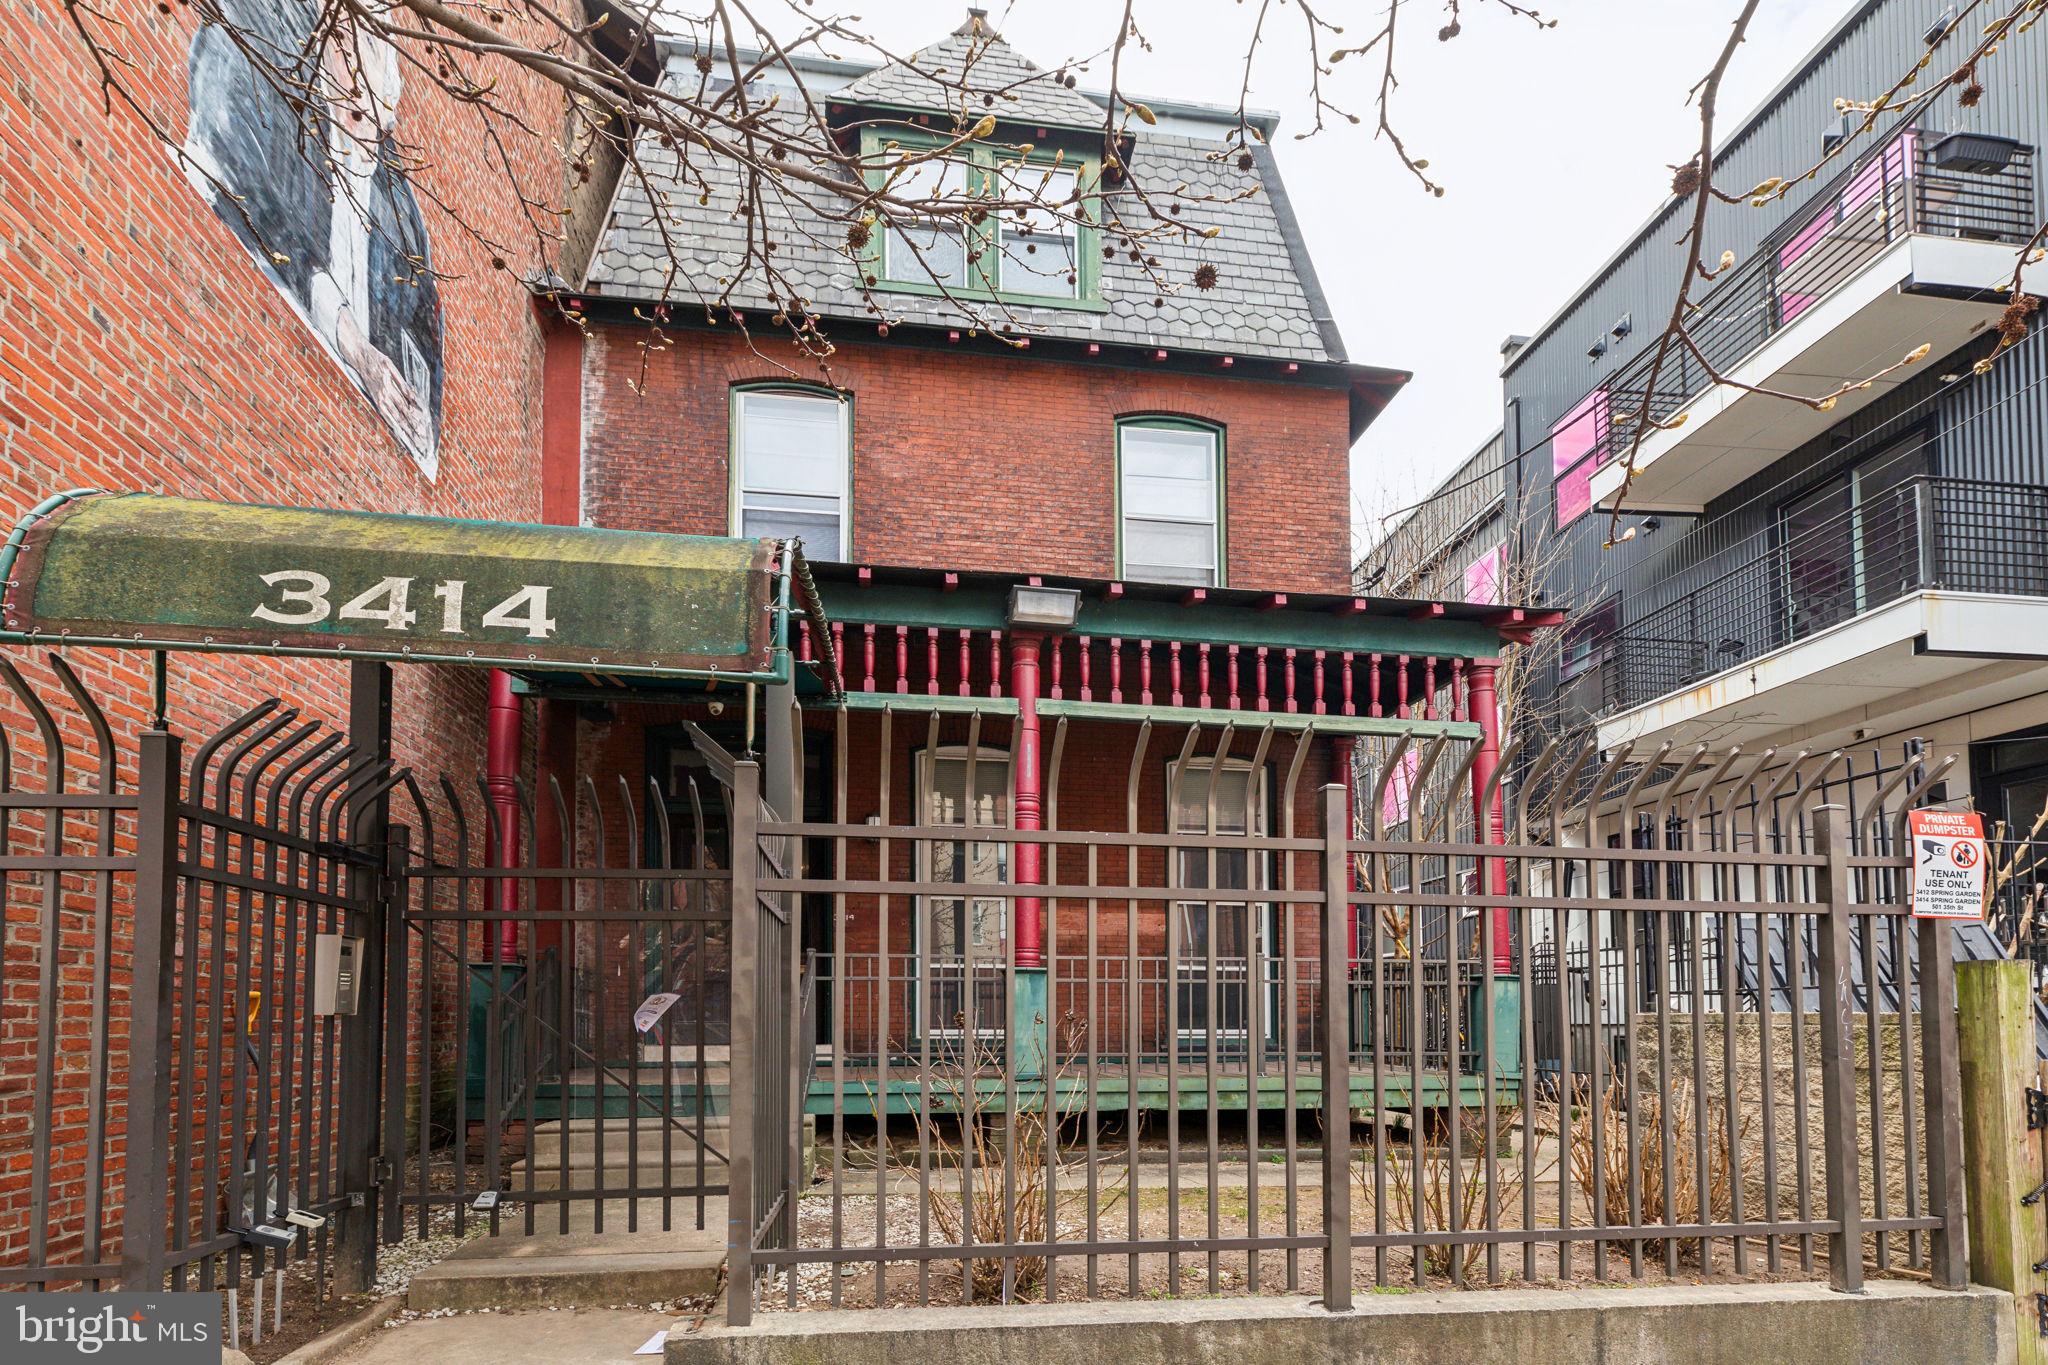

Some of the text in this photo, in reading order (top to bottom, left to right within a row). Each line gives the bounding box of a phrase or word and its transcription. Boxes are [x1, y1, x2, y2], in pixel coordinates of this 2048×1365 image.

[251, 569, 556, 638] 3414
[1924, 814, 1966, 825] PRIVATE
[1919, 824, 1975, 836] DUMPSTER
[1930, 869, 1968, 878] TENANT
[1925, 879, 1972, 888] USE ONLY
